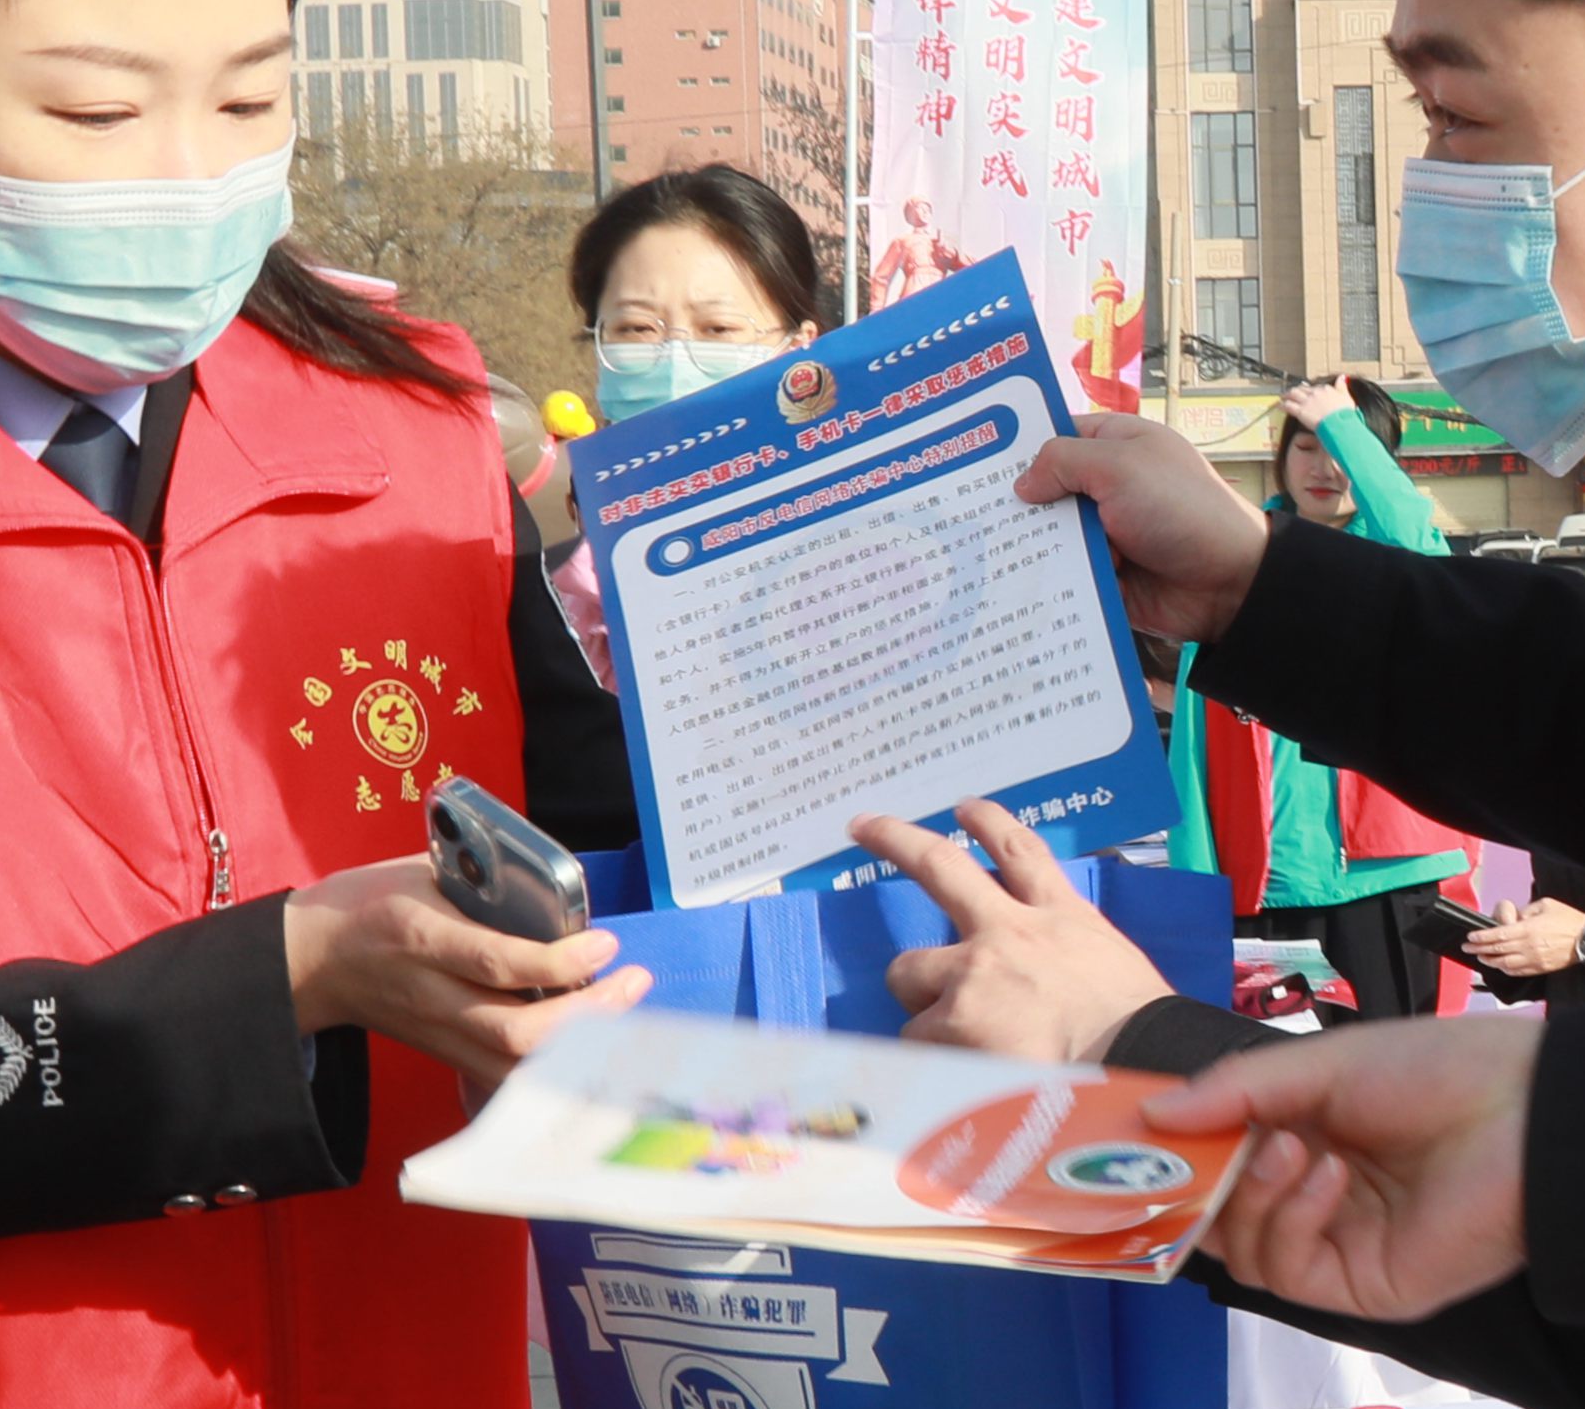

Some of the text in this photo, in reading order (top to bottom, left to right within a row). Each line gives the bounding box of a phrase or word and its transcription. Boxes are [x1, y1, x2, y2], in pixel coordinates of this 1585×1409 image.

[597, 329, 1030, 529] 对非法买卖银行卡、手机卡一律采取惩戒措施
[698, 419, 999, 553] 咸阳市反电信网络诈骗中心特别提醒
[289, 639, 484, 751] 全国文明城市
[33, 996, 65, 1108] POLICE
